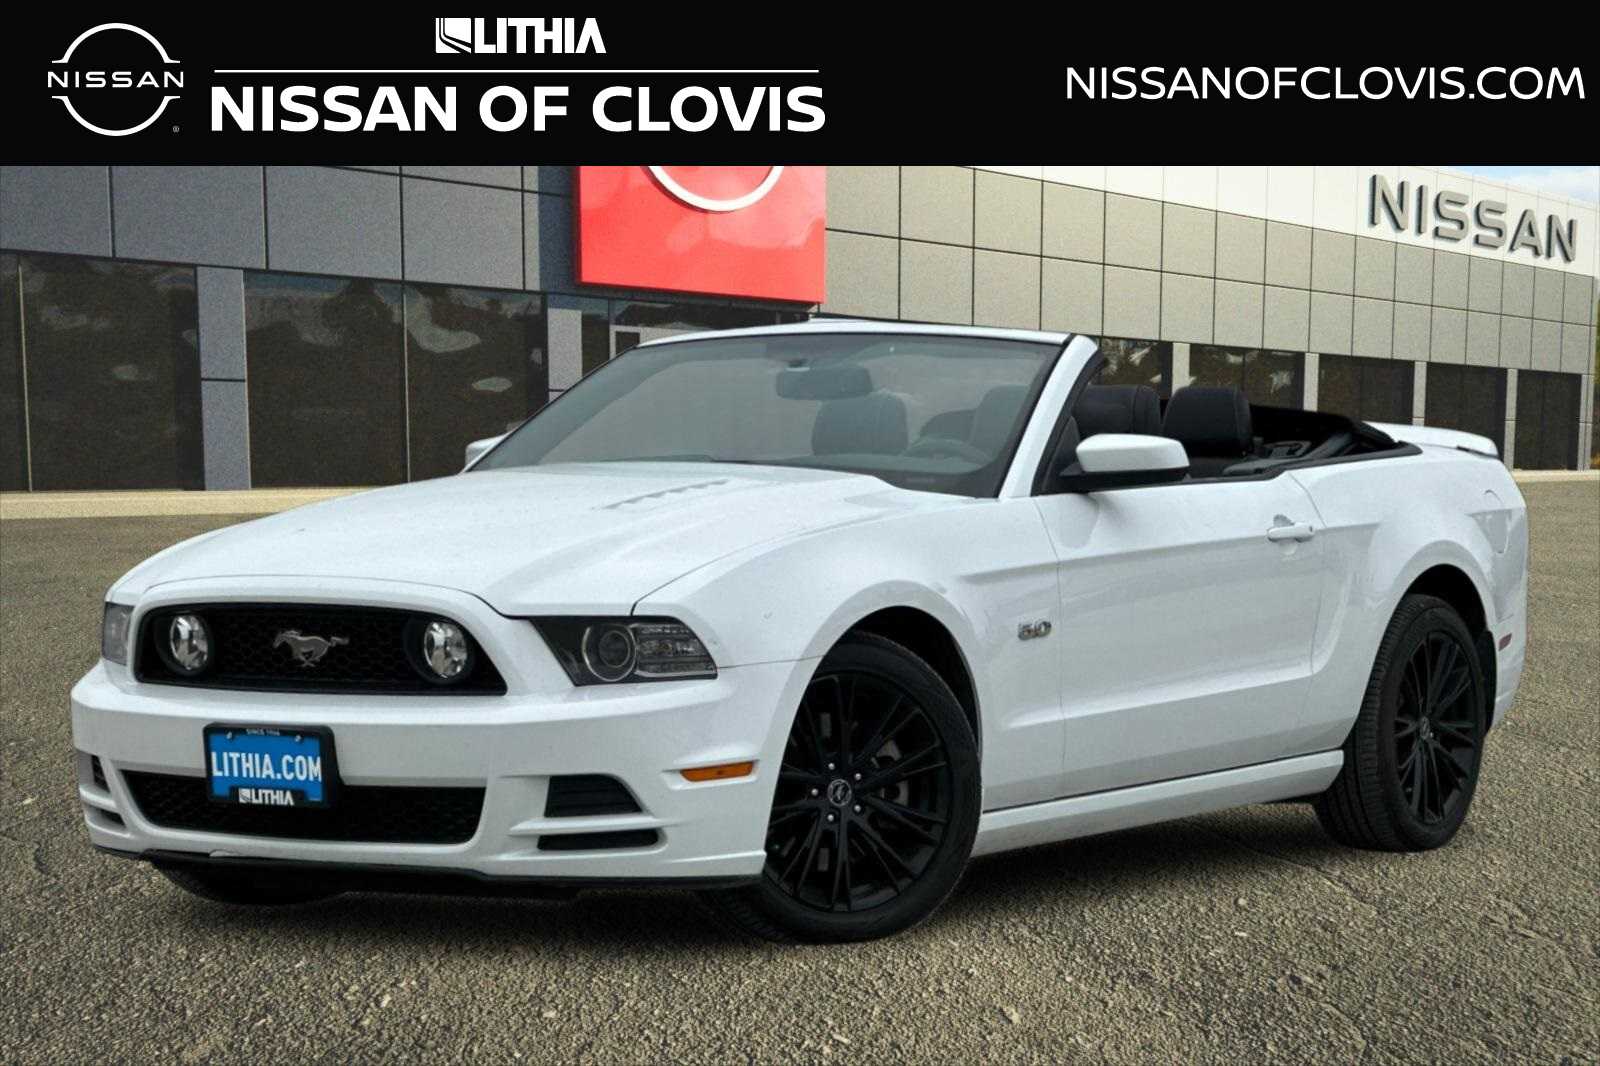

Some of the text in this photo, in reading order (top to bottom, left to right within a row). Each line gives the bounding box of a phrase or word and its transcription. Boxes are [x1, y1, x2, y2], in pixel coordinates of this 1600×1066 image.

[1369, 174, 1577, 263] NISSAN
[211, 751, 322, 782] LITHIA.COM
[251, 788, 294, 806] LITHIA
